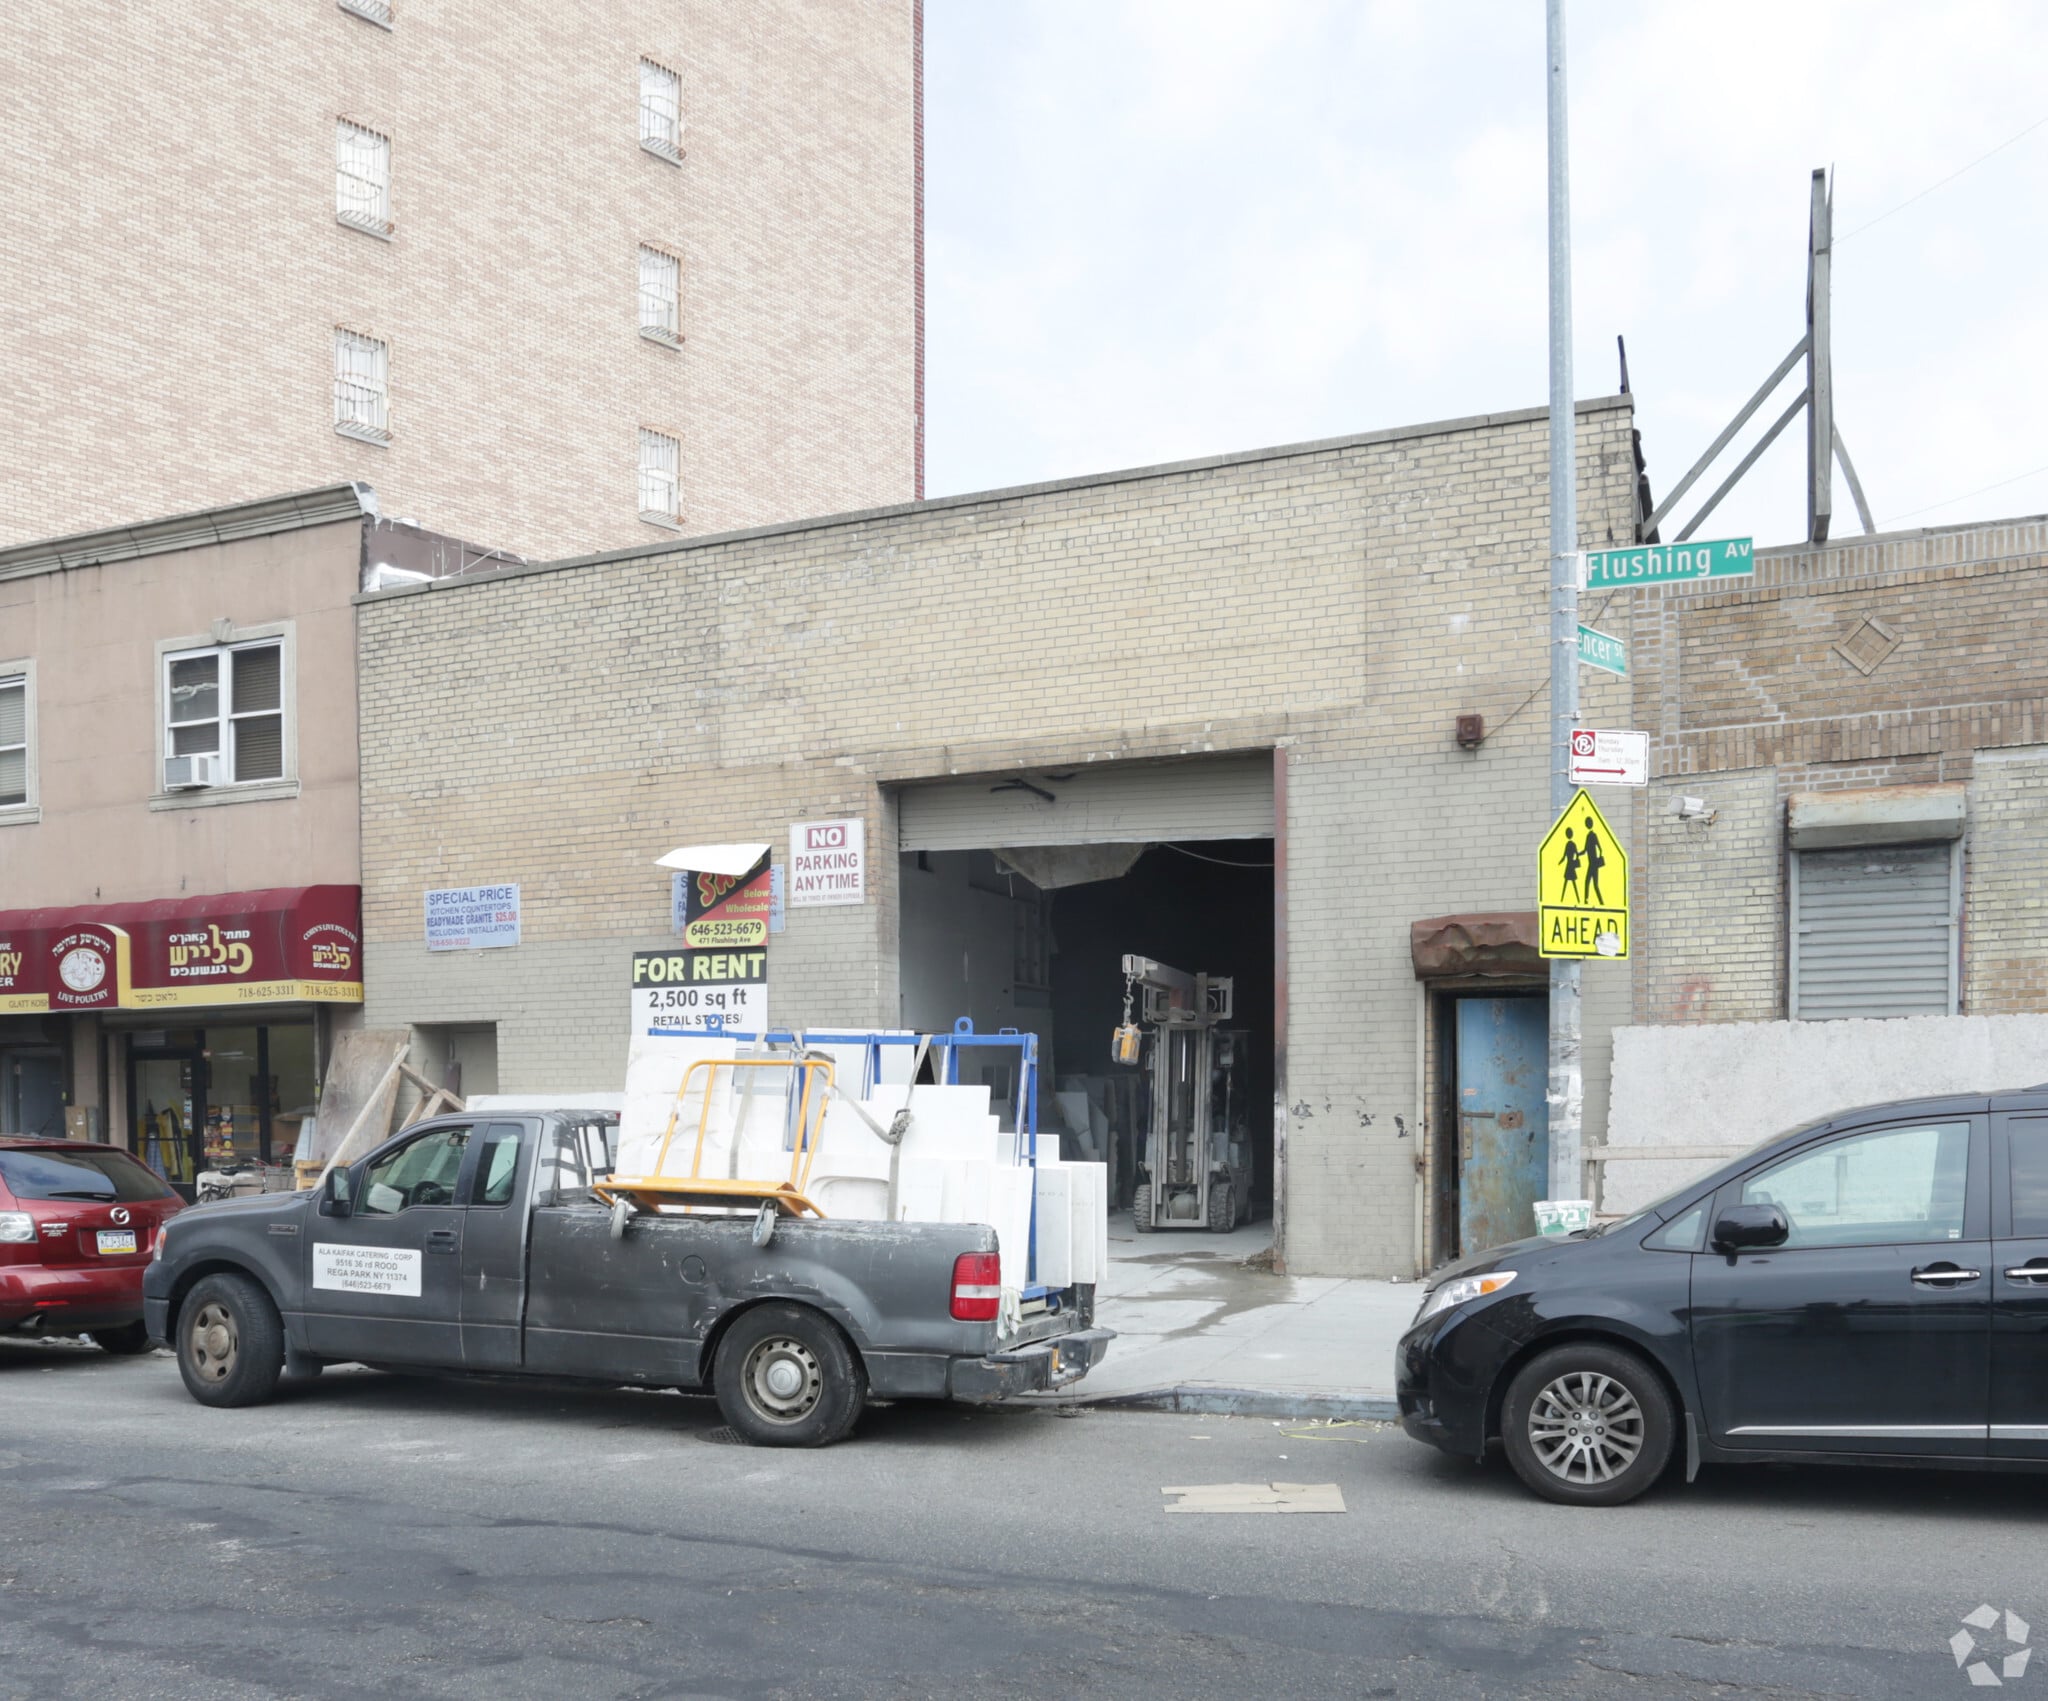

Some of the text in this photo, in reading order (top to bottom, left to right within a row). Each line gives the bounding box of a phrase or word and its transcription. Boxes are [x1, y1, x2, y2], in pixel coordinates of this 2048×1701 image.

[1587, 542, 1750, 578] Flushing Av
[811, 828, 842, 847] NO
[795, 852, 858, 871] PARKING
[795, 873, 859, 891] ANYTIME
[429, 887, 513, 906] SPECIAL PRICE
[743, 888, 769, 898] Below
[430, 902, 512, 916] KITCHEN COUNTERTOPS
[725, 903, 769, 913] Wholesale
[427, 915, 465, 927] READYMADE
[466, 913, 493, 925] GRANITE
[428, 924, 515, 937] INCLUDING INSTALLATION
[691, 922, 763, 936] 646-523-6679
[1551, 916, 1619, 944] AHEAD
[711, 936, 738, 945] Flushing
[633, 953, 765, 983] FOR RENT
[57, 988, 108, 1004] LIVE POULTRY
[238, 985, 295, 998] 718-625-3311
[305, 985, 360, 997] 718-625-3311
[8, 1000, 29, 1008] GLATT
[649, 987, 747, 1011] 2,500 sq ft
[653, 1015, 691, 1026] RETAIL
[319, 1248, 331, 1256] ALA
[356, 1251, 389, 1260] CATERING
[394, 1253, 413, 1261] CORP
[365, 1261, 373, 1269] rd
[374, 1261, 398, 1270] ROOD
[327, 1268, 407, 1281] REGA PARK NY 11374
